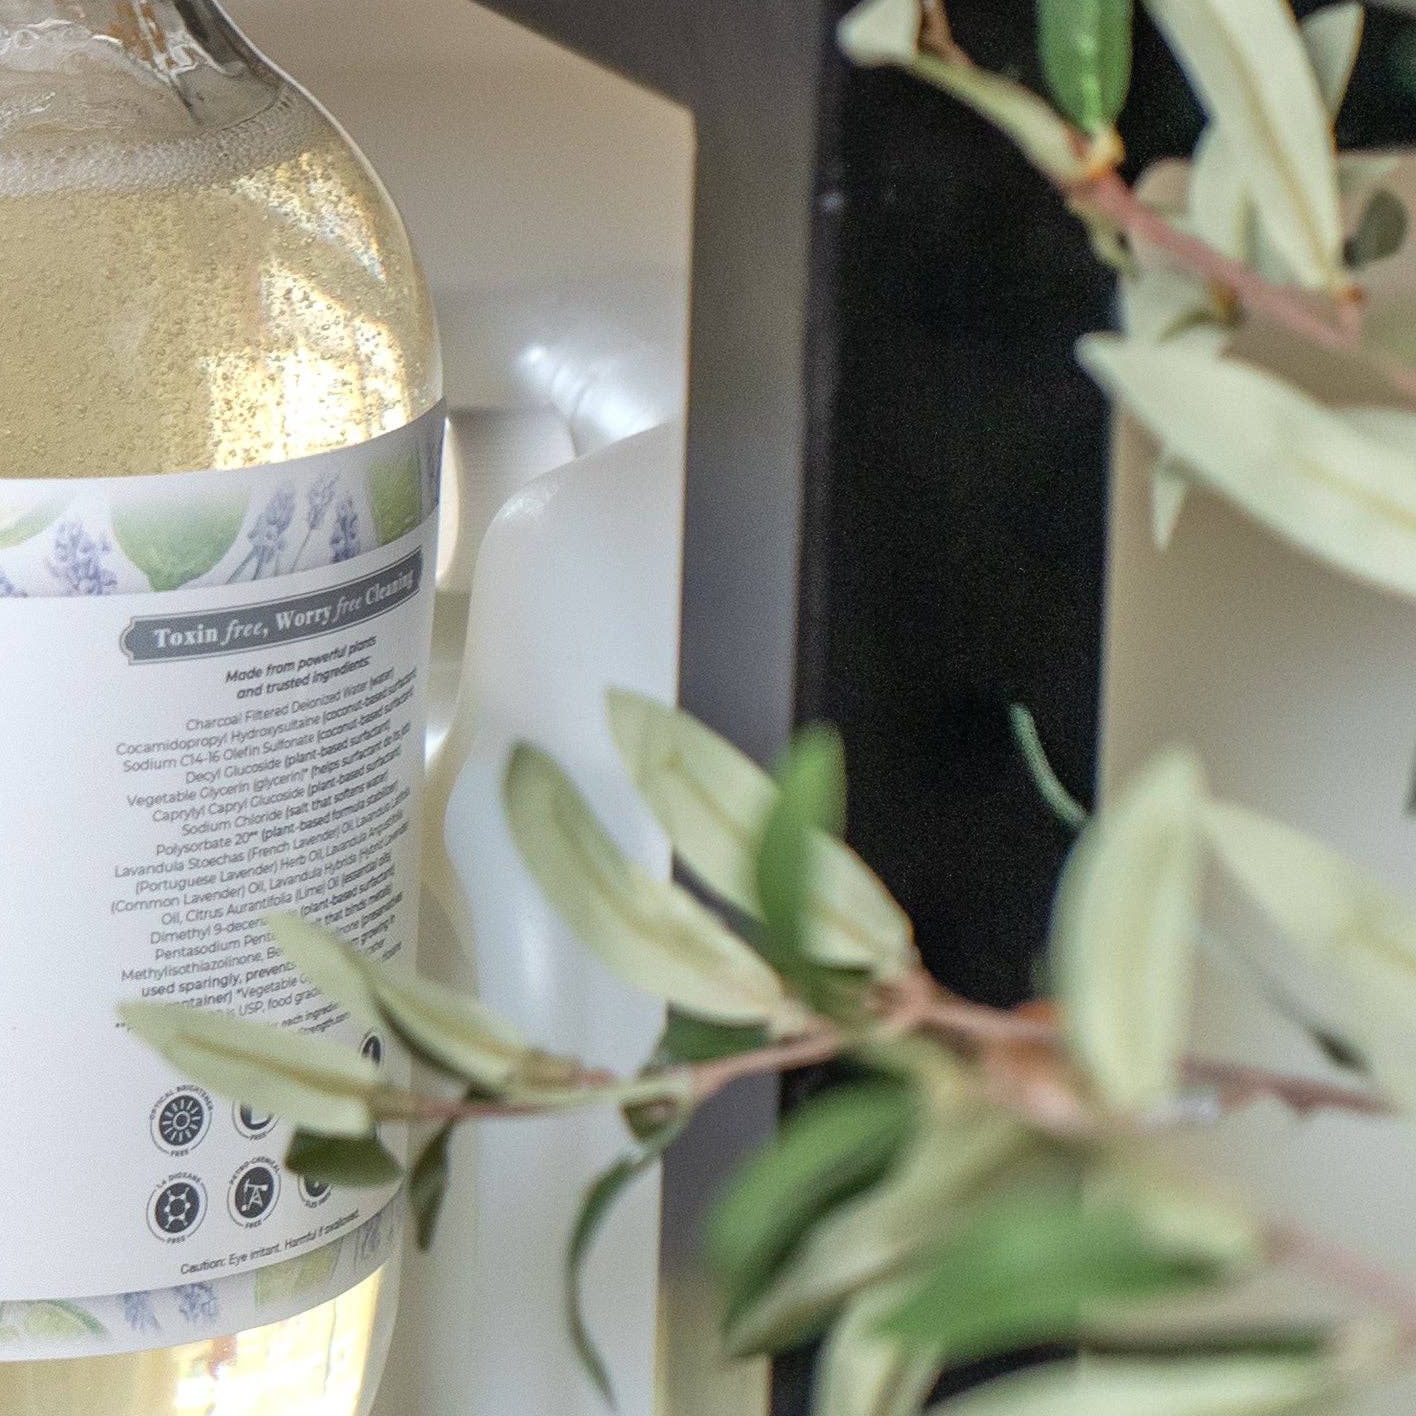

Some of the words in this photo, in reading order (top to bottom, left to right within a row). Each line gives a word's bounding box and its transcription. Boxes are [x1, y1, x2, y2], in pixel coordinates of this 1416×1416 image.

[154, 624, 218, 646] Toxin
[220, 618, 268, 645] free,
[274, 606, 331, 629] Worry
[333, 595, 361, 622] free
[226, 667, 262, 682] Made
[266, 661, 294, 675] from
[297, 645, 347, 671] powerful
[347, 635, 376, 656] plants
[237, 683, 263, 699] and
[266, 673, 310, 693] trusted
[186, 712, 241, 731] Charcoal
[245, 704, 287, 721] Filtered
[291, 689, 340, 713] Deionized
[116, 733, 227, 755] Cocamidopropyl
[123, 758, 176, 772] Sodium
[223, 745, 259, 760] Olefin
[186, 768, 220, 784] Decyl
[224, 758, 281, 777] Glucoside
[126, 790, 196, 807] Vegetable
[199, 782, 249, 799] Glycerin
[207, 798, 247, 815] Capryl
[250, 786, 304, 807] Glucoside
[182, 820, 230, 836] Sodium
[234, 809, 281, 828] Chloride
[156, 837, 231, 856] Polysorbate
[114, 861, 183, 878] Lavandula
[188, 852, 243, 869] Stoechas
[111, 896, 179, 913] (Common
[186, 907, 223, 922] Citrus
[150, 925, 210, 944] Dimethyl
[155, 939, 240, 960] Pentasodium
[141, 982, 174, 997] used
[178, 973, 240, 993] sparingly,
[267, 992, 292, 1009] food
[180, 1256, 226, 1275] Caution:
[229, 1250, 248, 1267] Eye
